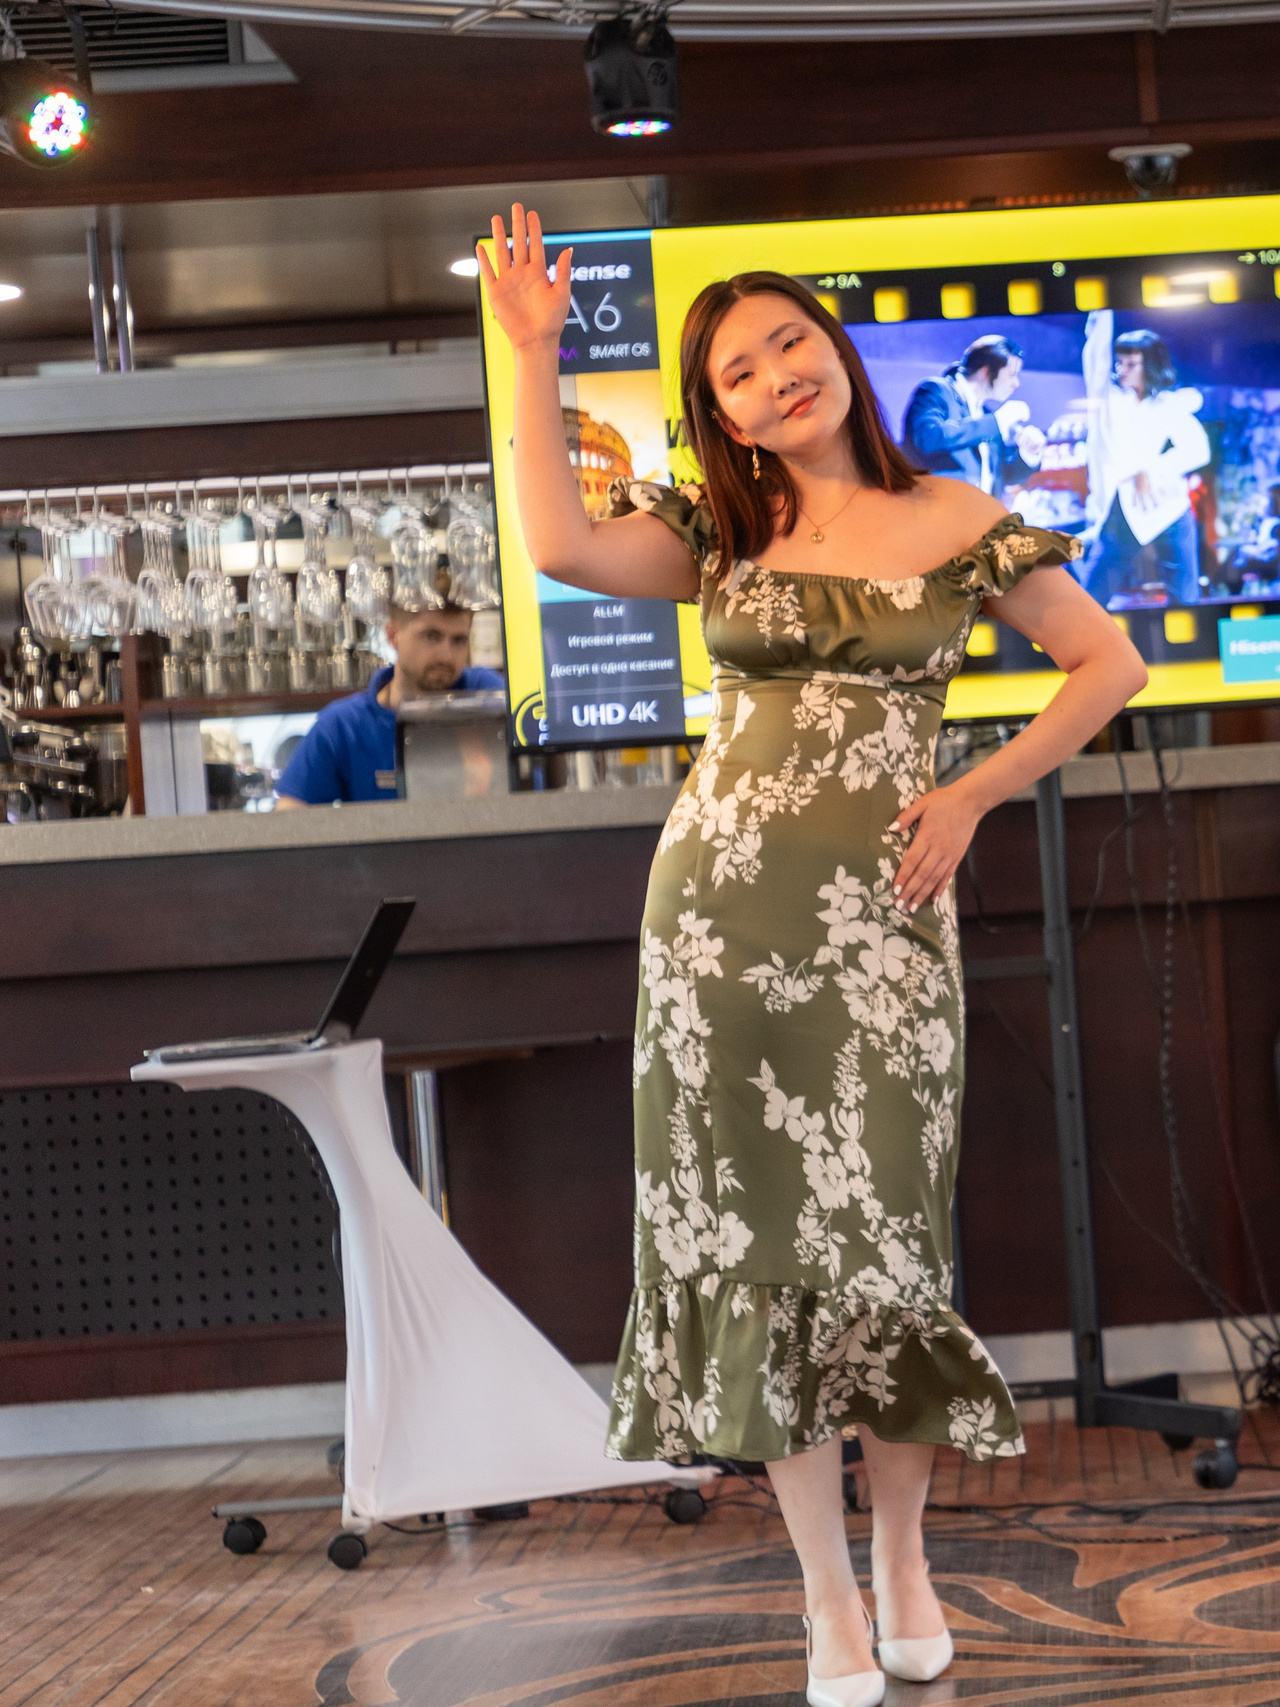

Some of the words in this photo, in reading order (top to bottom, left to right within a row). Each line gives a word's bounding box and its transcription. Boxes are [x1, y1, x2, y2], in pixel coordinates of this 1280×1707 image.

[1052, 261, 1066, 277] 9
[836, 273, 862, 289] 9A
[589, 344, 629, 360] SMART
[631, 342, 651, 357] OS
[593, 604, 625, 619] ALLM
[568, 633, 614, 649] Игровой
[616, 632, 655, 647] режим
[550, 663, 590, 679] Доступ
[600, 661, 627, 675] одно
[629, 658, 676, 672] касание
[571, 702, 626, 727] UHD
[628, 700, 660, 723] 4K
